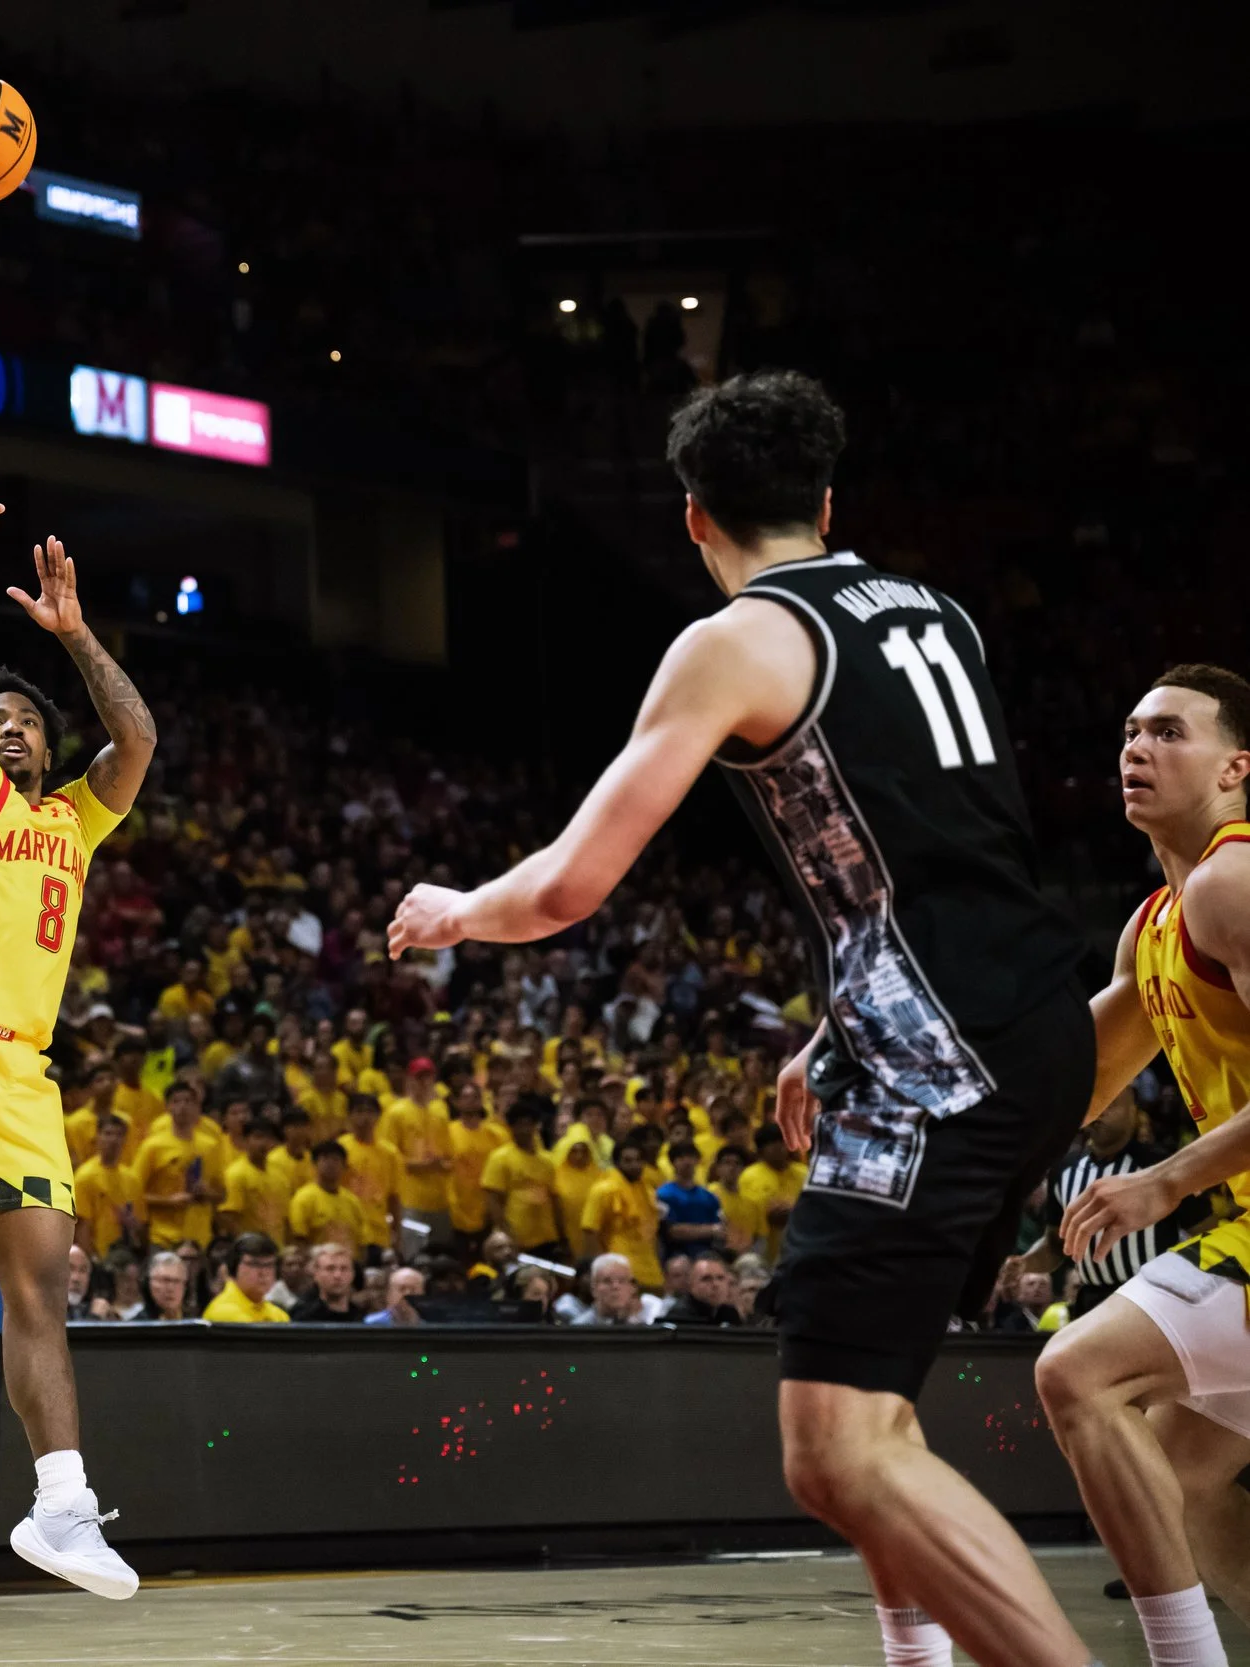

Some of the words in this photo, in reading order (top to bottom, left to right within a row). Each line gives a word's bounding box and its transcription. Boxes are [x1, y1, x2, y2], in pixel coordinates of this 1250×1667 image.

[96, 371, 128, 428] M
[878, 622, 997, 770] 11
[36, 874, 69, 953] 8
